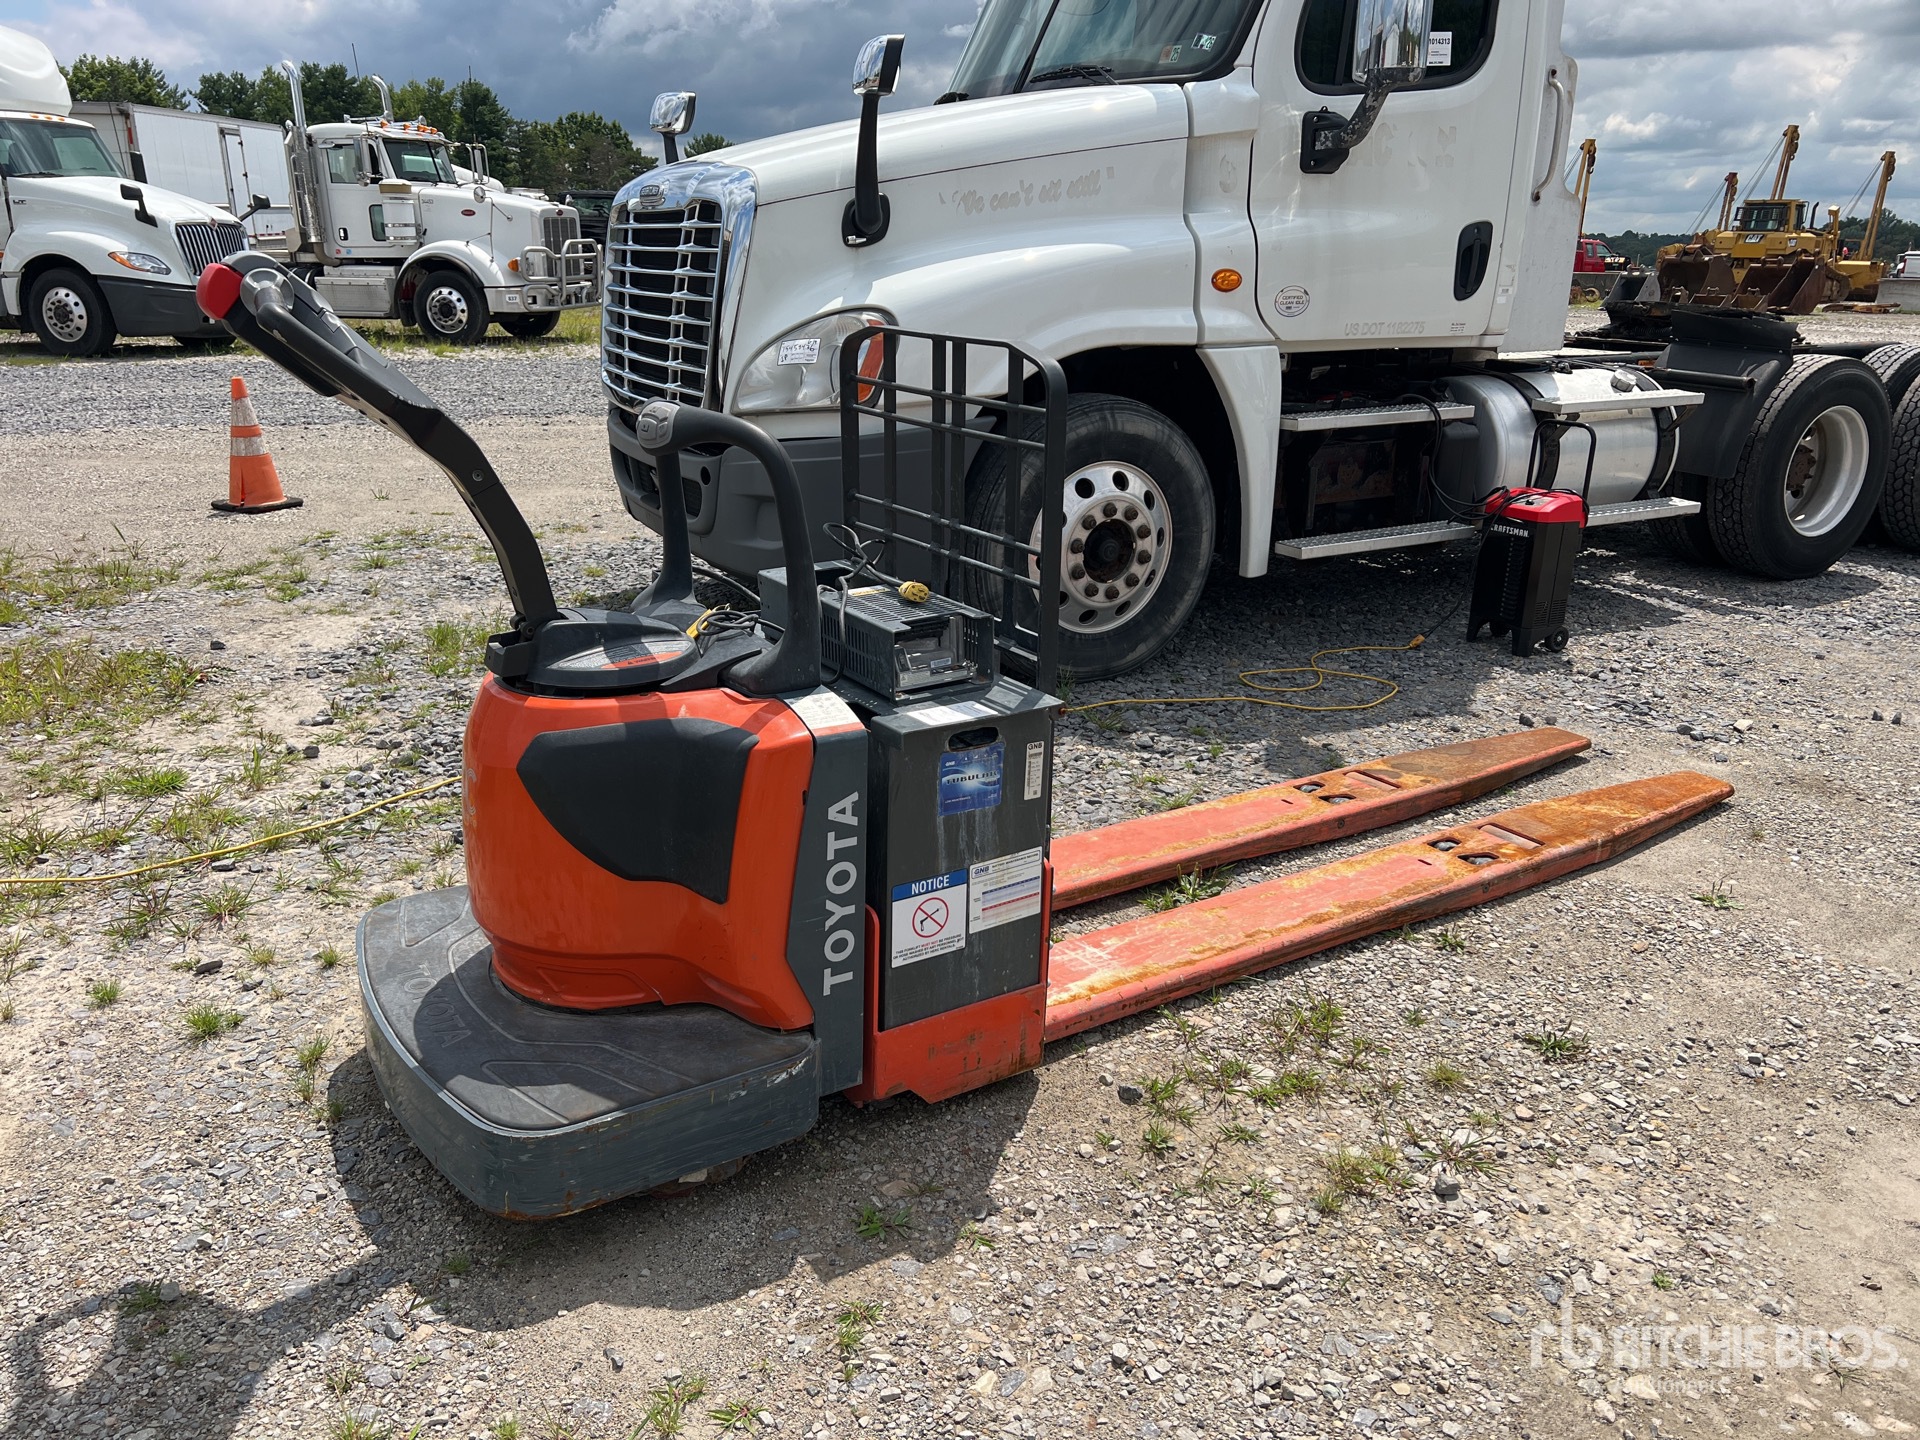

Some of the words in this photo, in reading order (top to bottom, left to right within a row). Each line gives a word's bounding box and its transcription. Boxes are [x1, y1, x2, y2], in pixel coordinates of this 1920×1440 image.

[1746, 234, 1763, 243] CAT
[1344, 322, 1359, 336] US
[1361, 321, 1385, 335] DOT
[1028, 742, 1043, 750] GNB
[973, 866, 990, 875] GNB
[911, 875, 950, 895] NOTICE
[823, 791, 859, 996] TOYOTA
[904, 945, 921, 953] FORKLIFT
[902, 952, 925, 961] AUTHORIZED
